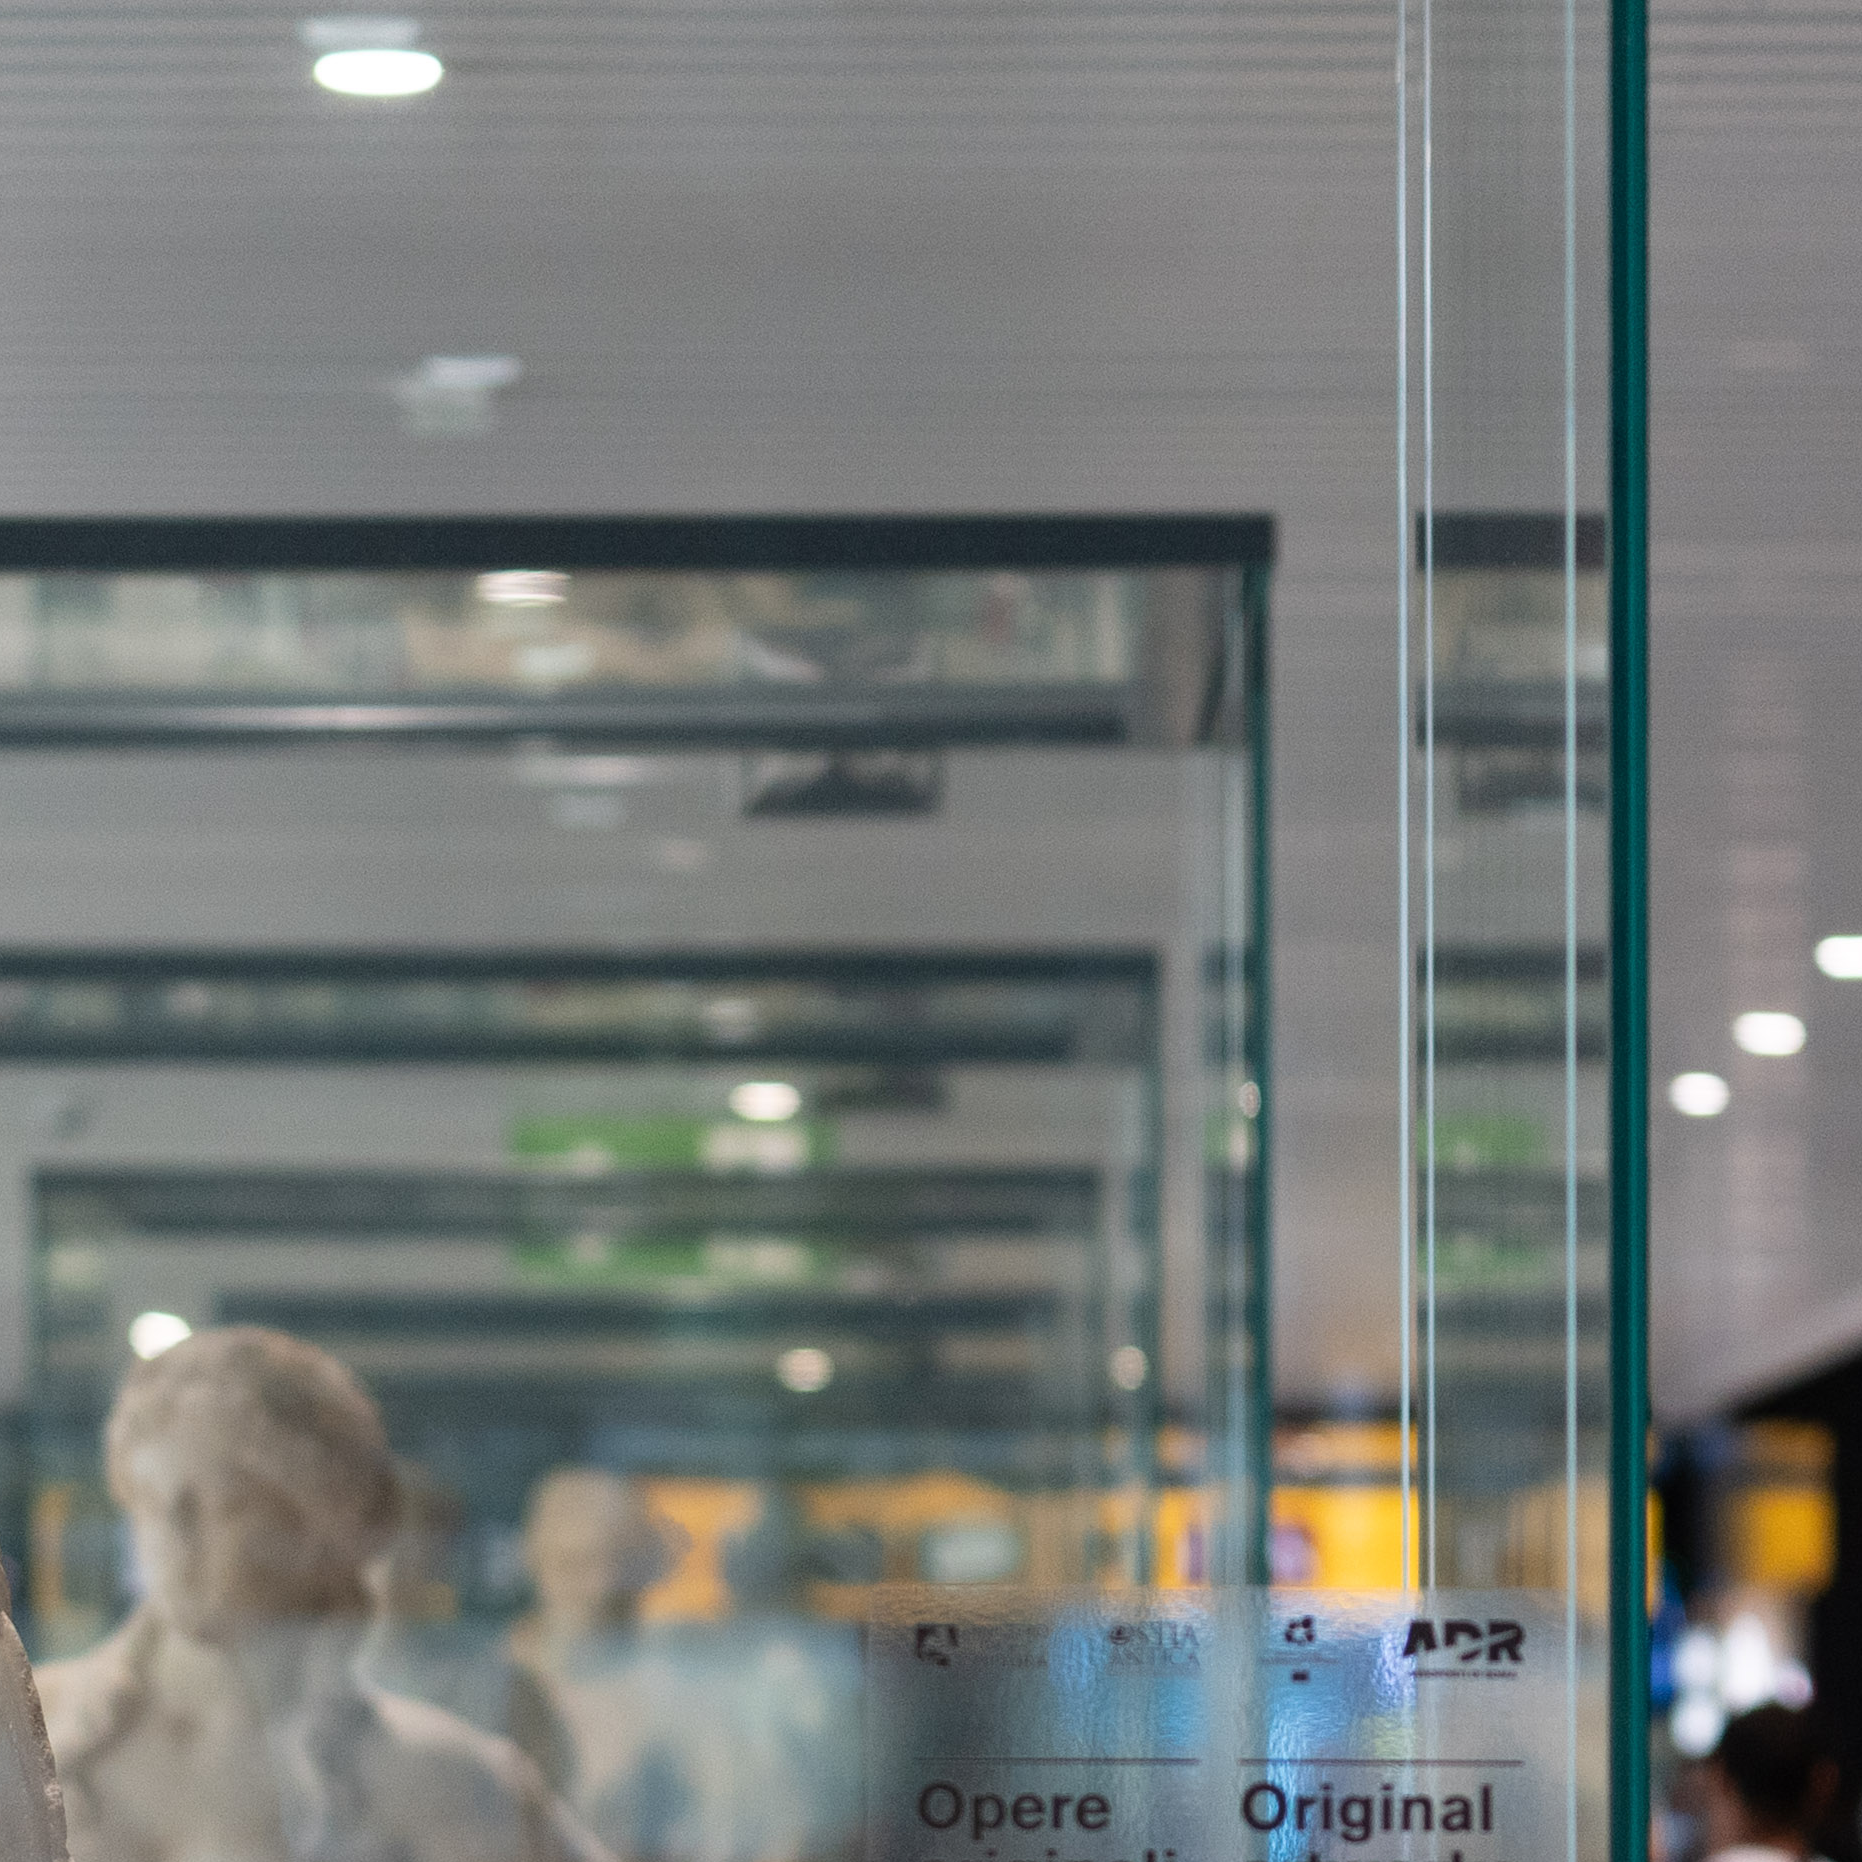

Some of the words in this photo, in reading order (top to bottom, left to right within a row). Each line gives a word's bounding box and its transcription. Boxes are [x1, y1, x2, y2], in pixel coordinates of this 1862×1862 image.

[1403, 1619, 1525, 1661] ADR
[918, 1783, 1111, 1839] Opere
[1241, 1783, 1493, 1841] Original
